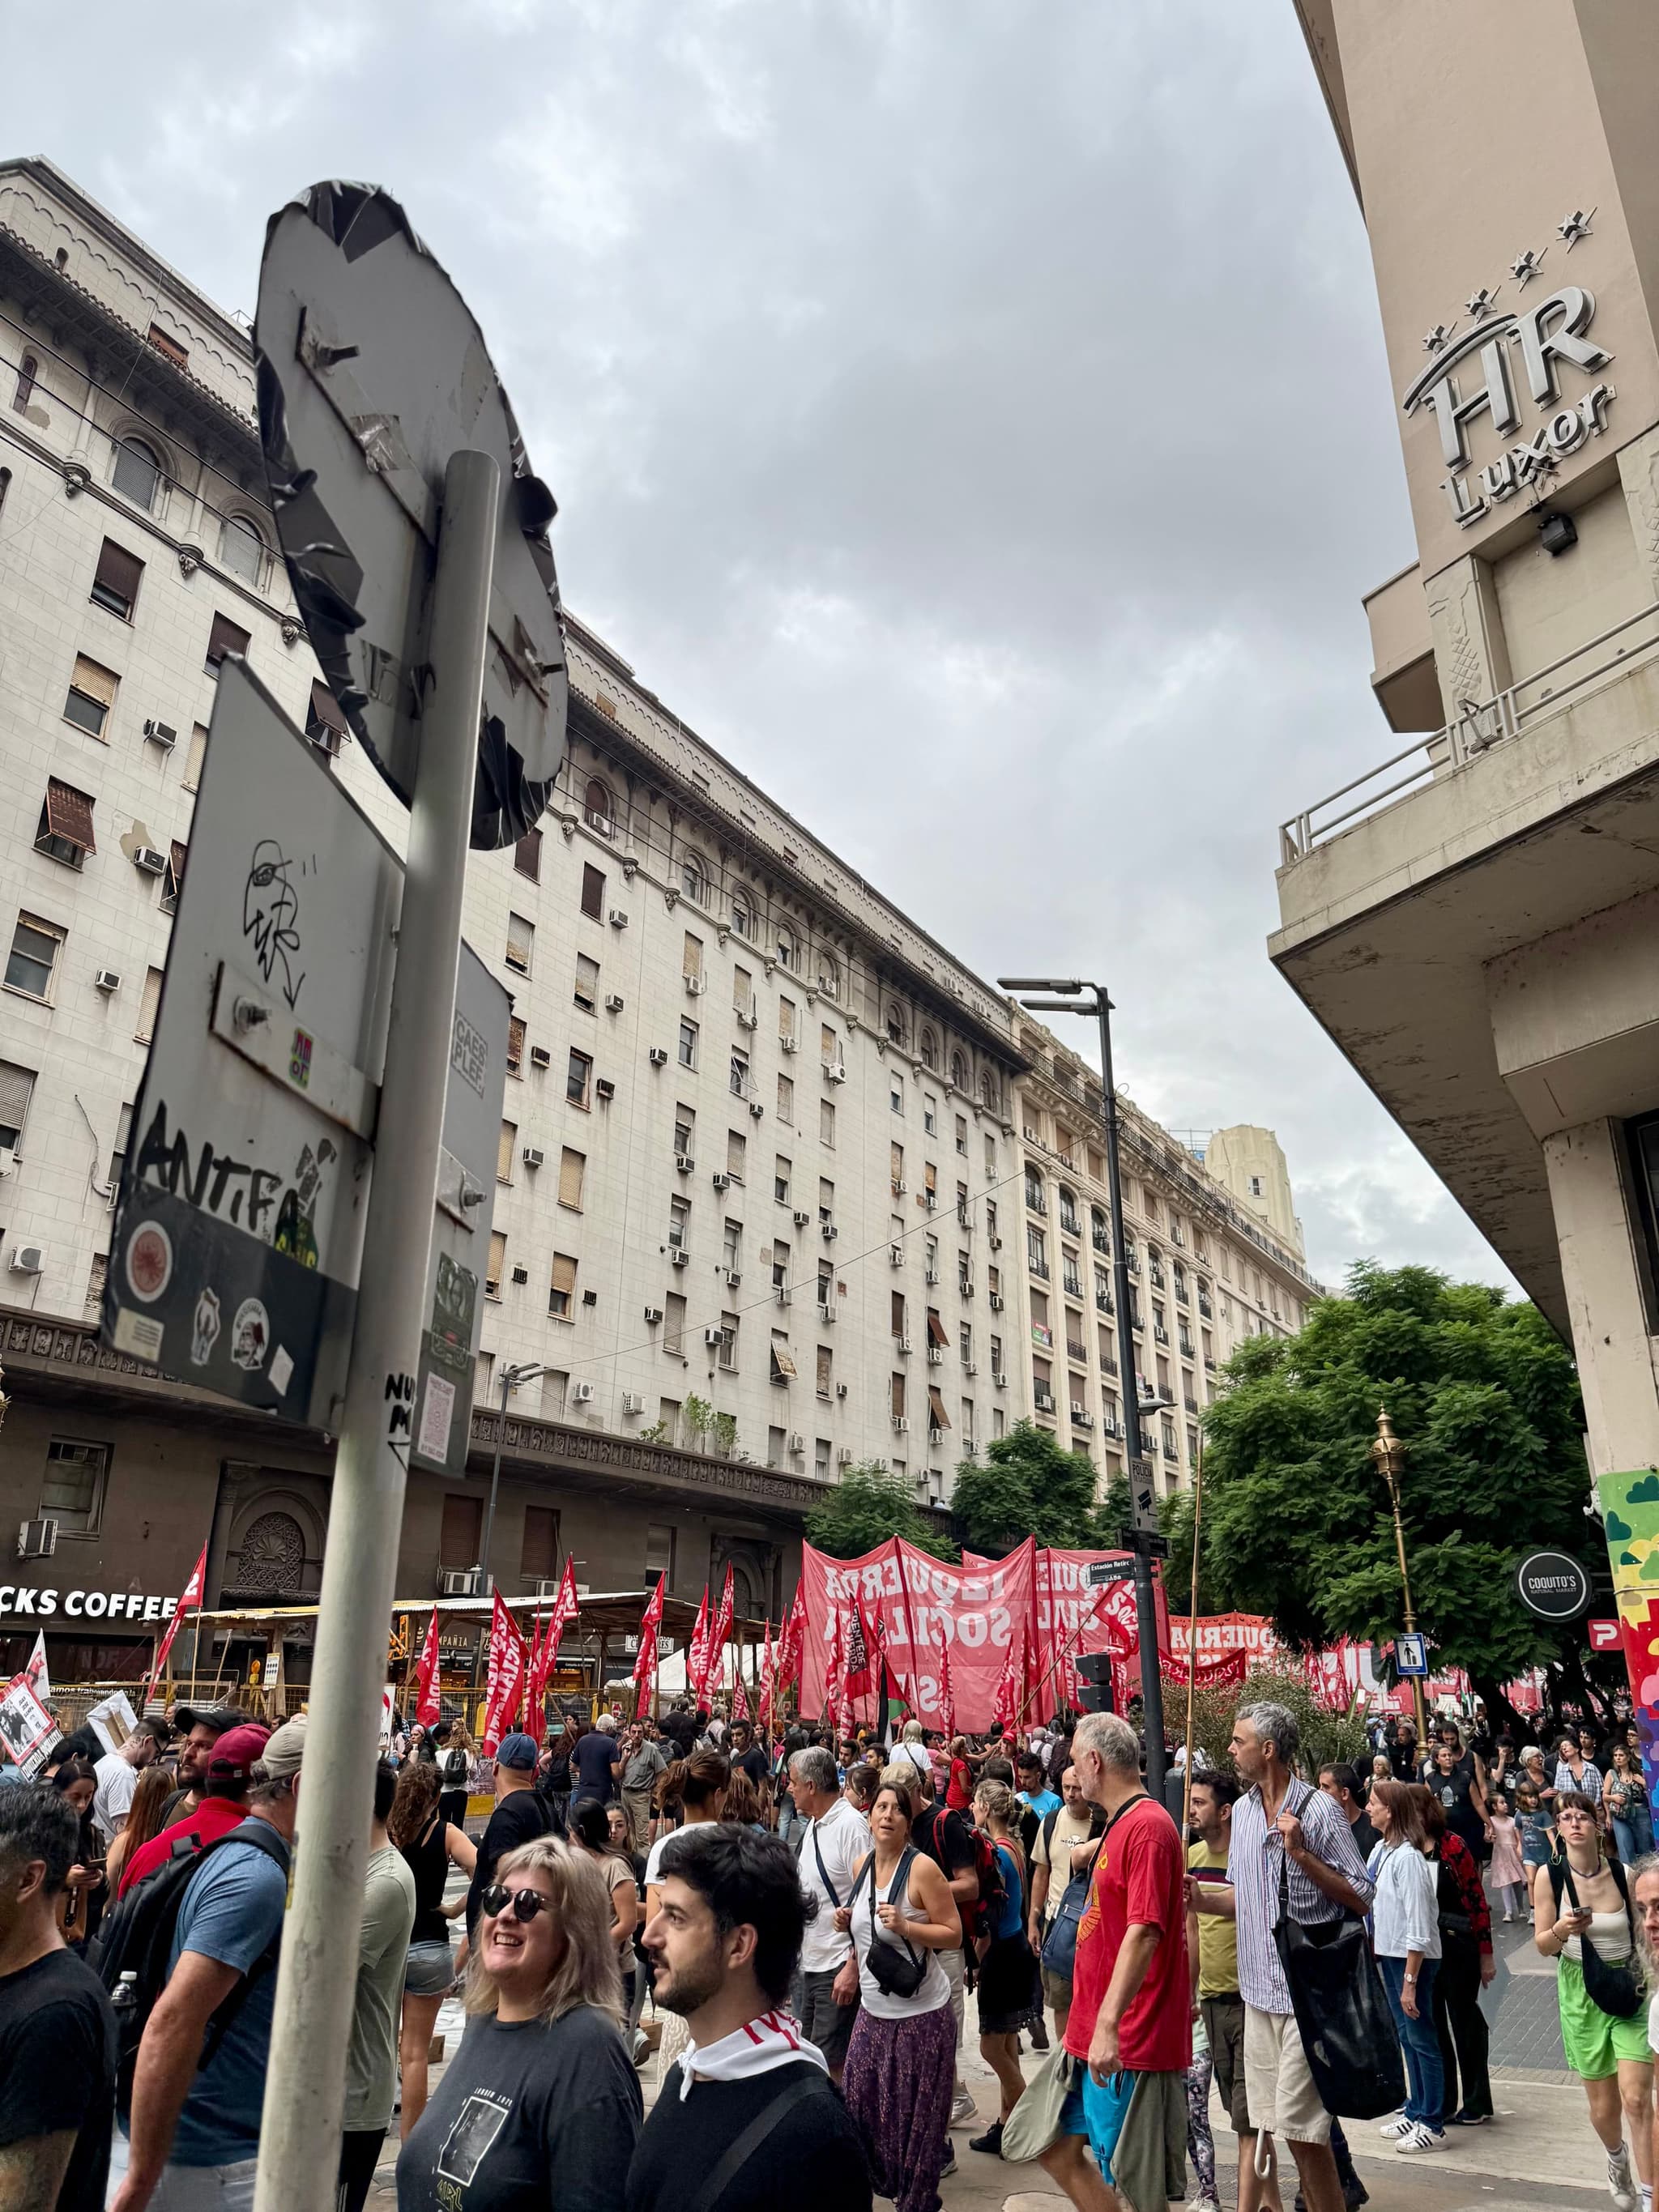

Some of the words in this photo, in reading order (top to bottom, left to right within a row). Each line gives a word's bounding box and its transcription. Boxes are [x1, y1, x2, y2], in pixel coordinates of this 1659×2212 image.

[1439, 384, 1617, 530] Luxor
[1528, 1575, 1576, 1590] COQUITO'S
[65, 1590, 179, 1619] COFFEE
